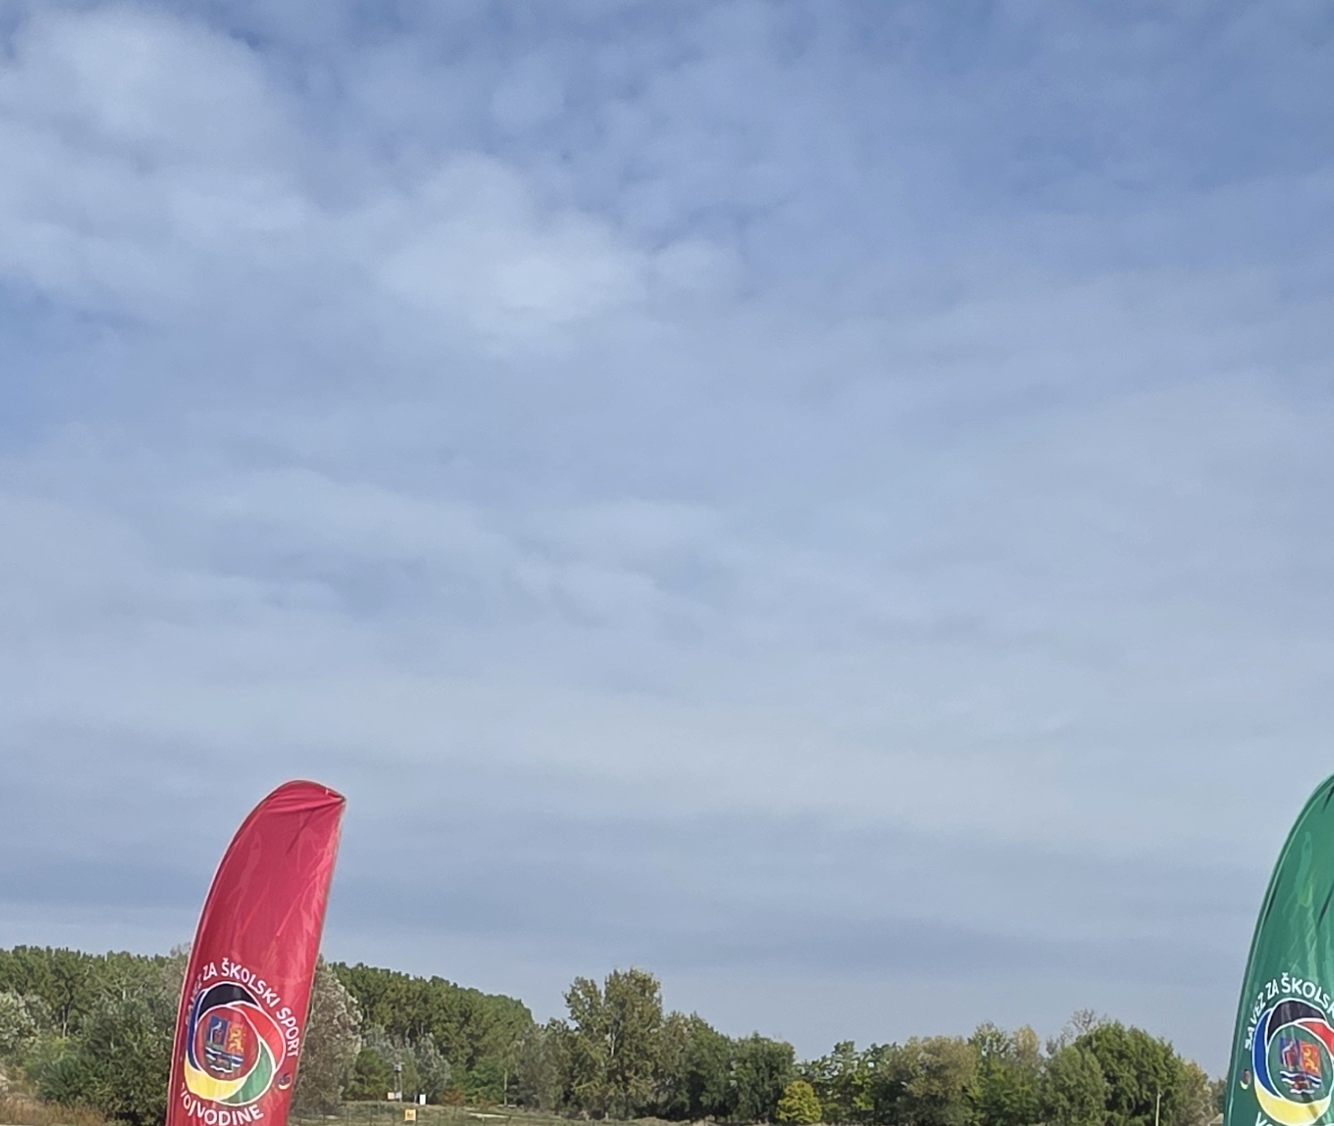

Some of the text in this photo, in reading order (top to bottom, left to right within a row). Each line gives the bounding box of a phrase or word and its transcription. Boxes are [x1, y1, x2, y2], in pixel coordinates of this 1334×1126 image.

[203, 962, 218, 981] ZA
[221, 957, 281, 1008] ŠKOLSKI
[276, 1007, 301, 1057] SPORT
[1265, 978, 1280, 1001] ZA
